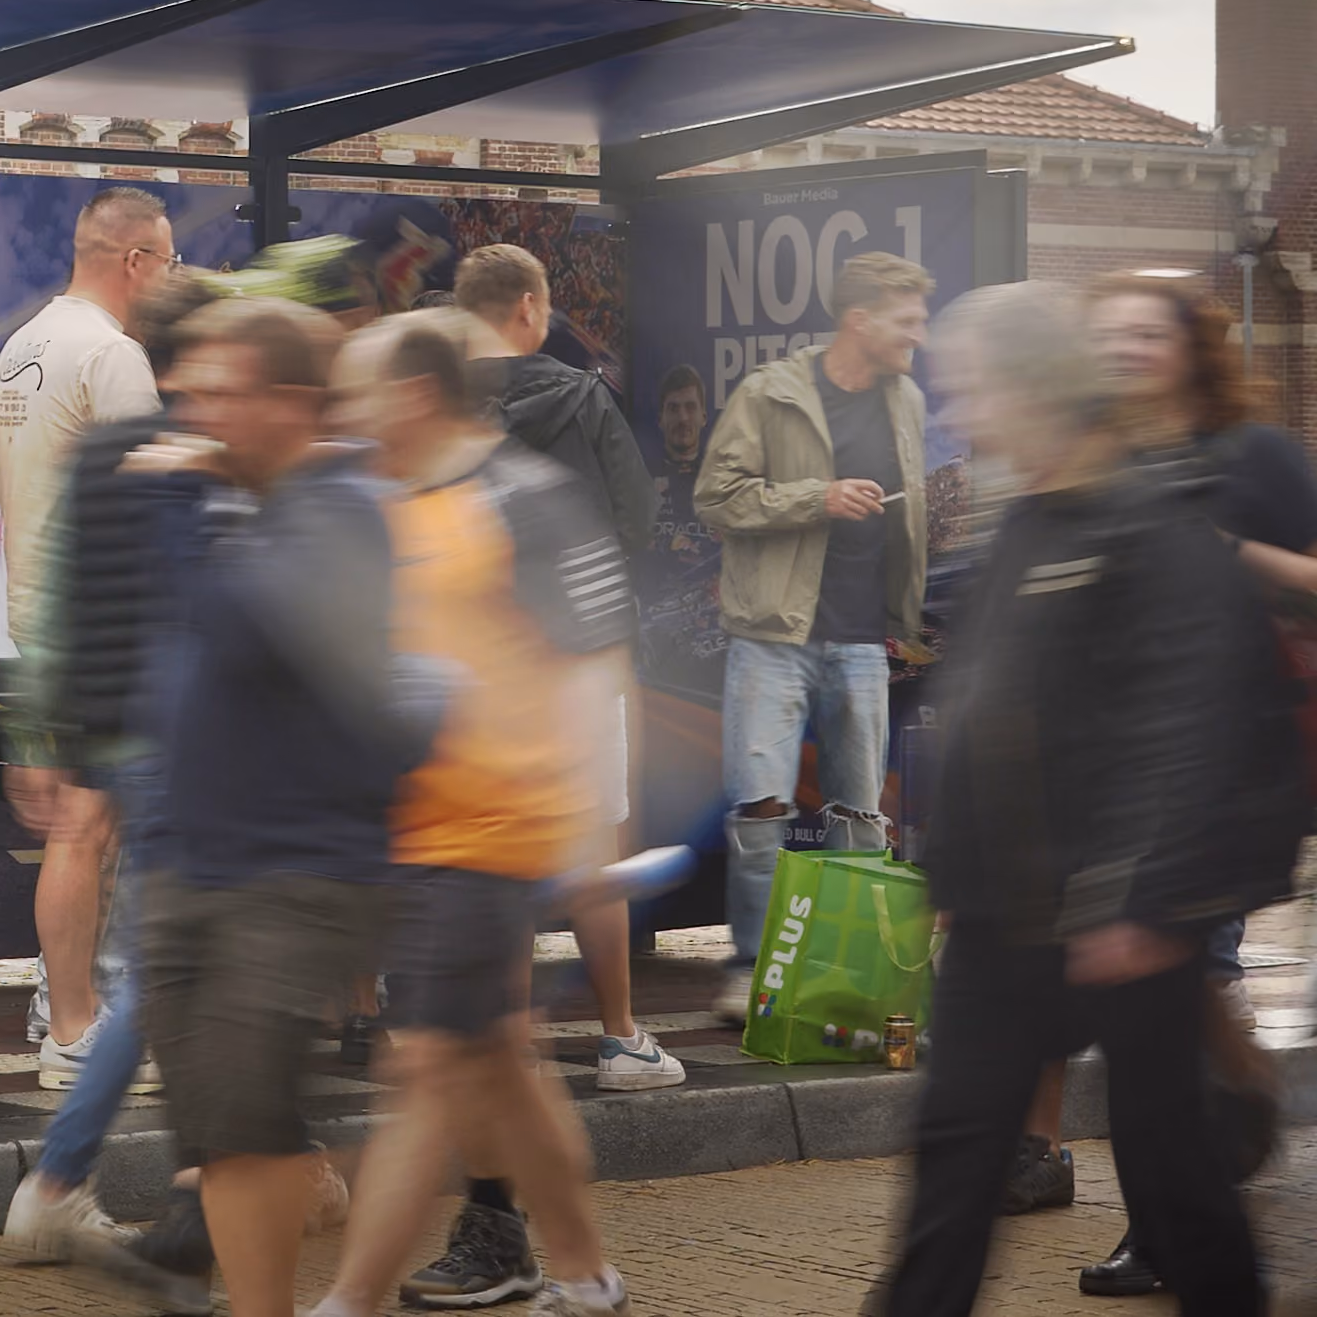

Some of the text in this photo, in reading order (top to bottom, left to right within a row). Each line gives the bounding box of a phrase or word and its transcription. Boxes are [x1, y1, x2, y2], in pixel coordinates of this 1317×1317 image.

[763, 188, 838, 206] Bauer Media
[763, 894, 812, 990] PLUS
